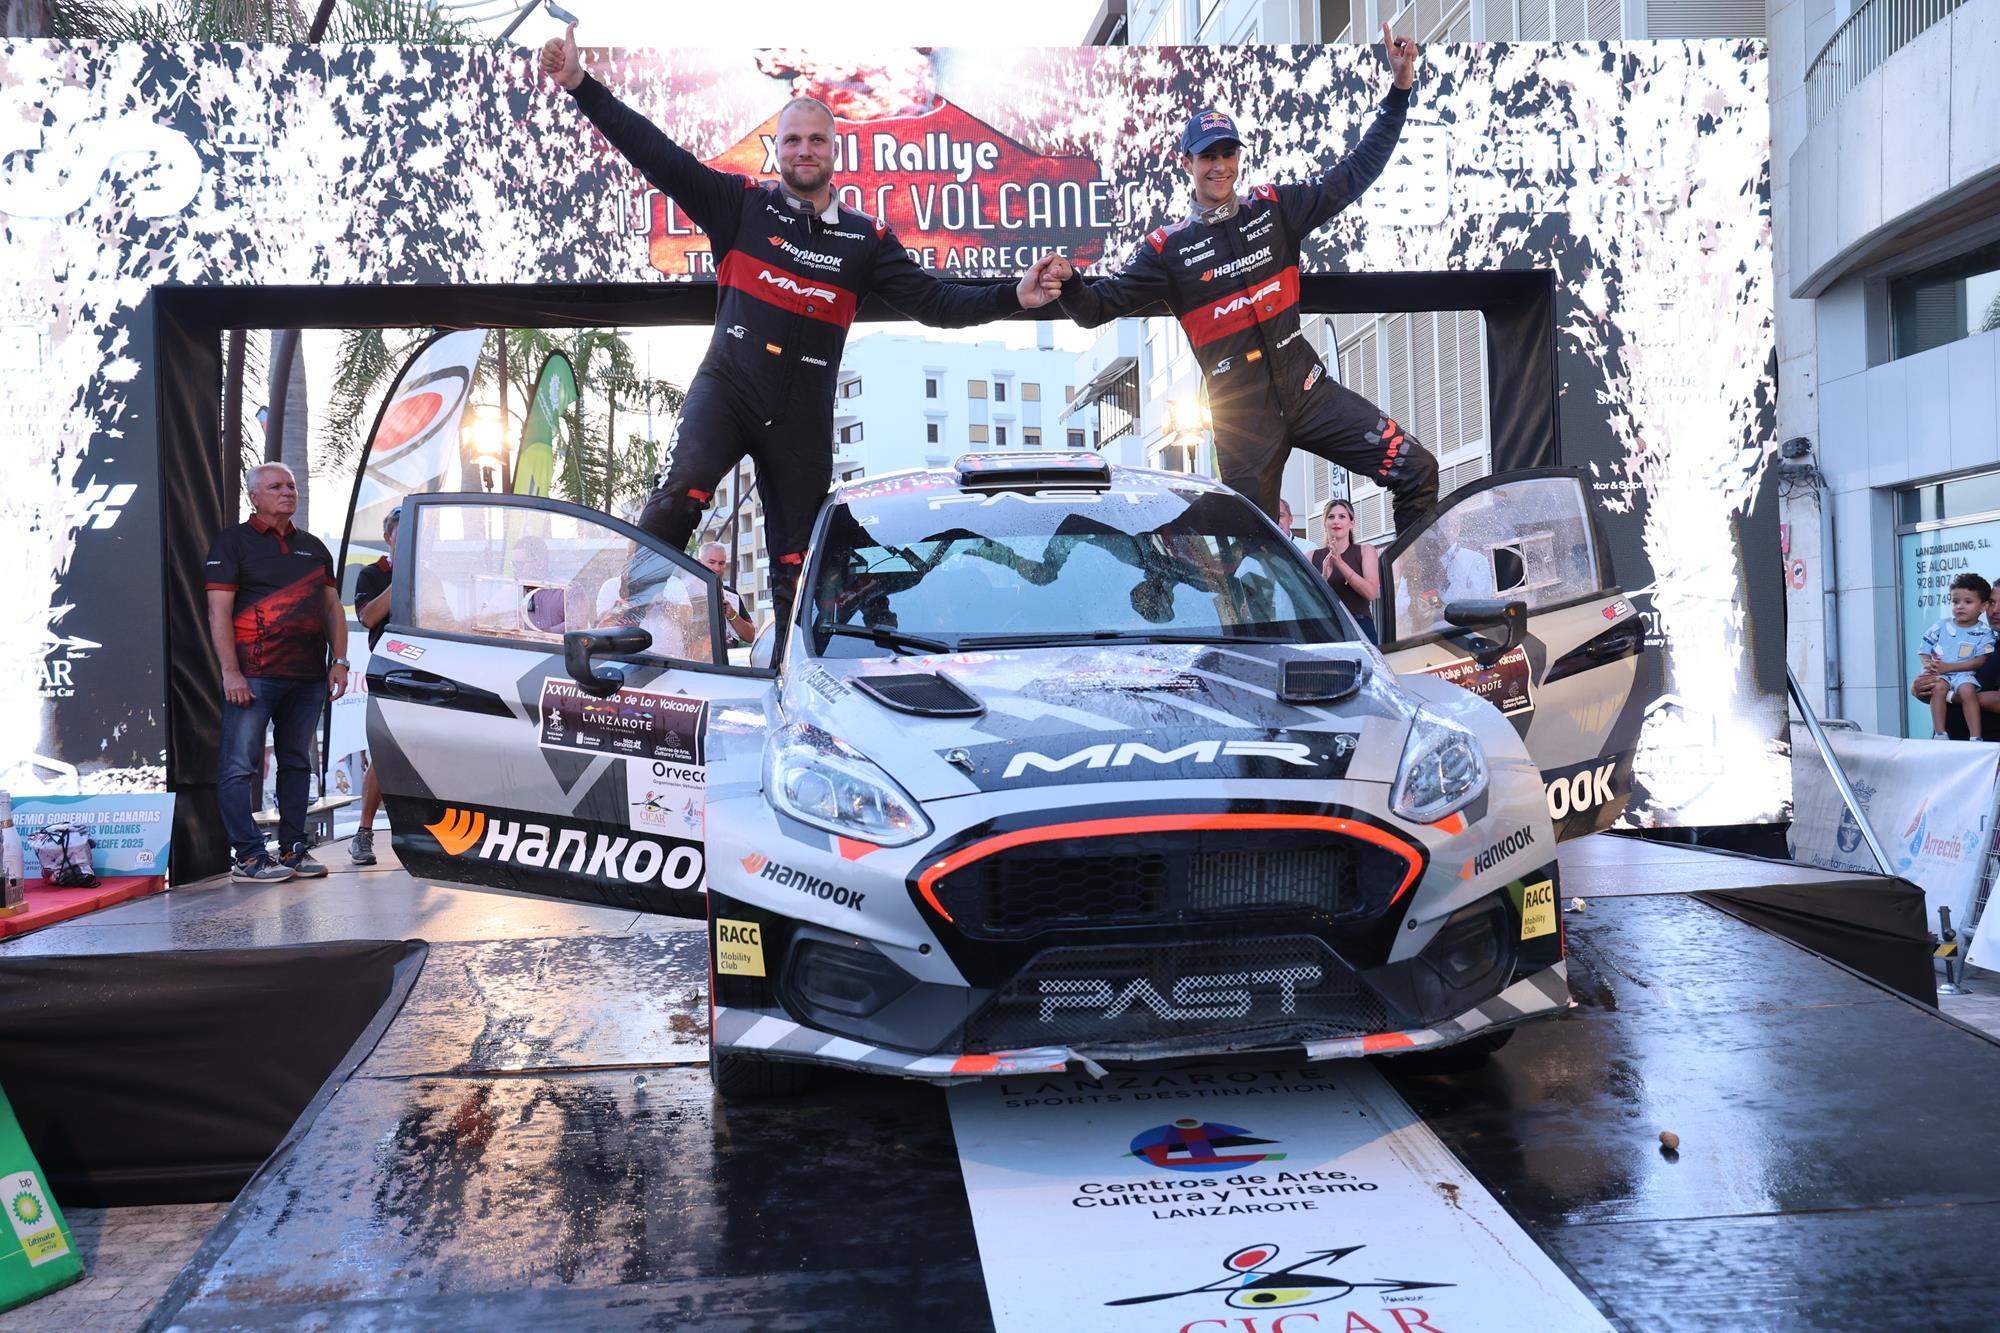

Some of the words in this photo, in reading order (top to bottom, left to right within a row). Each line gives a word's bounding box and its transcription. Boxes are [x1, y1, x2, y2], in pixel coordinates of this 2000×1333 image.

[760, 134, 858, 173] XII
[873, 133, 999, 183] Rallye
[617, 188, 703, 236] ISL
[910, 181, 1141, 231] VOLCANES
[823, 228, 866, 241] M-SPORT
[758, 269, 837, 304] MMR
[1213, 280, 1283, 321] MMR
[1619, 482, 1647, 491] Spor
[1915, 541, 1976, 558] LANZABUILDING,
[1978, 538, 1991, 549] S.L.
[1916, 560, 1927, 574] SE
[1929, 558, 1969, 573] ALQUILA
[1917, 577, 1933, 590] 928
[1936, 574, 1951, 588] 807
[1917, 595, 1933, 608] 670
[1936, 592, 1952, 607] 749
[1643, 637, 1666, 648] anary
[1470, 679, 1503, 694] ZAROTE
[546, 684, 576, 698] XXVII
[624, 694, 636, 706] de
[640, 695, 656, 708] Los
[659, 696, 702, 714] Volcanes
[582, 712, 653, 731] LANZAROTE
[1001, 740, 1319, 779] MMR
[12, 812, 45, 826] REMIO
[98, 811, 110, 823] DE
[112, 810, 161, 823] CANARIAS
[98, 824, 141, 835] VOLCANES
[96, 840, 119, 850] ECIFE
[121, 838, 144, 849] 2025
[1921, 831, 1962, 860] Arrecife
[1525, 885, 1552, 909] RACC
[1524, 914, 1546, 924] Mobility
[719, 925, 759, 946] RACC
[1523, 926, 1536, 935] Club
[720, 951, 751, 963] Mobility
[720, 961, 738, 970] Club
[1039, 965, 1322, 1023] PAST
[1001, 1067, 1327, 1096] LANZAROTE
[1004, 1093, 1121, 1109] SPORTS
[1133, 1081, 1338, 1101] DESTINATION
[19, 1178, 32, 1189] bp
[1079, 1176, 1219, 1195] Centros
[1224, 1173, 1268, 1187] de
[1277, 1168, 1357, 1184] Arte,
[1071, 1189, 1205, 1209] Cultura
[1211, 1190, 1231, 1203] y
[1239, 1181, 1379, 1199] Turismo
[1152, 1200, 1320, 1220] LANZAROTE
